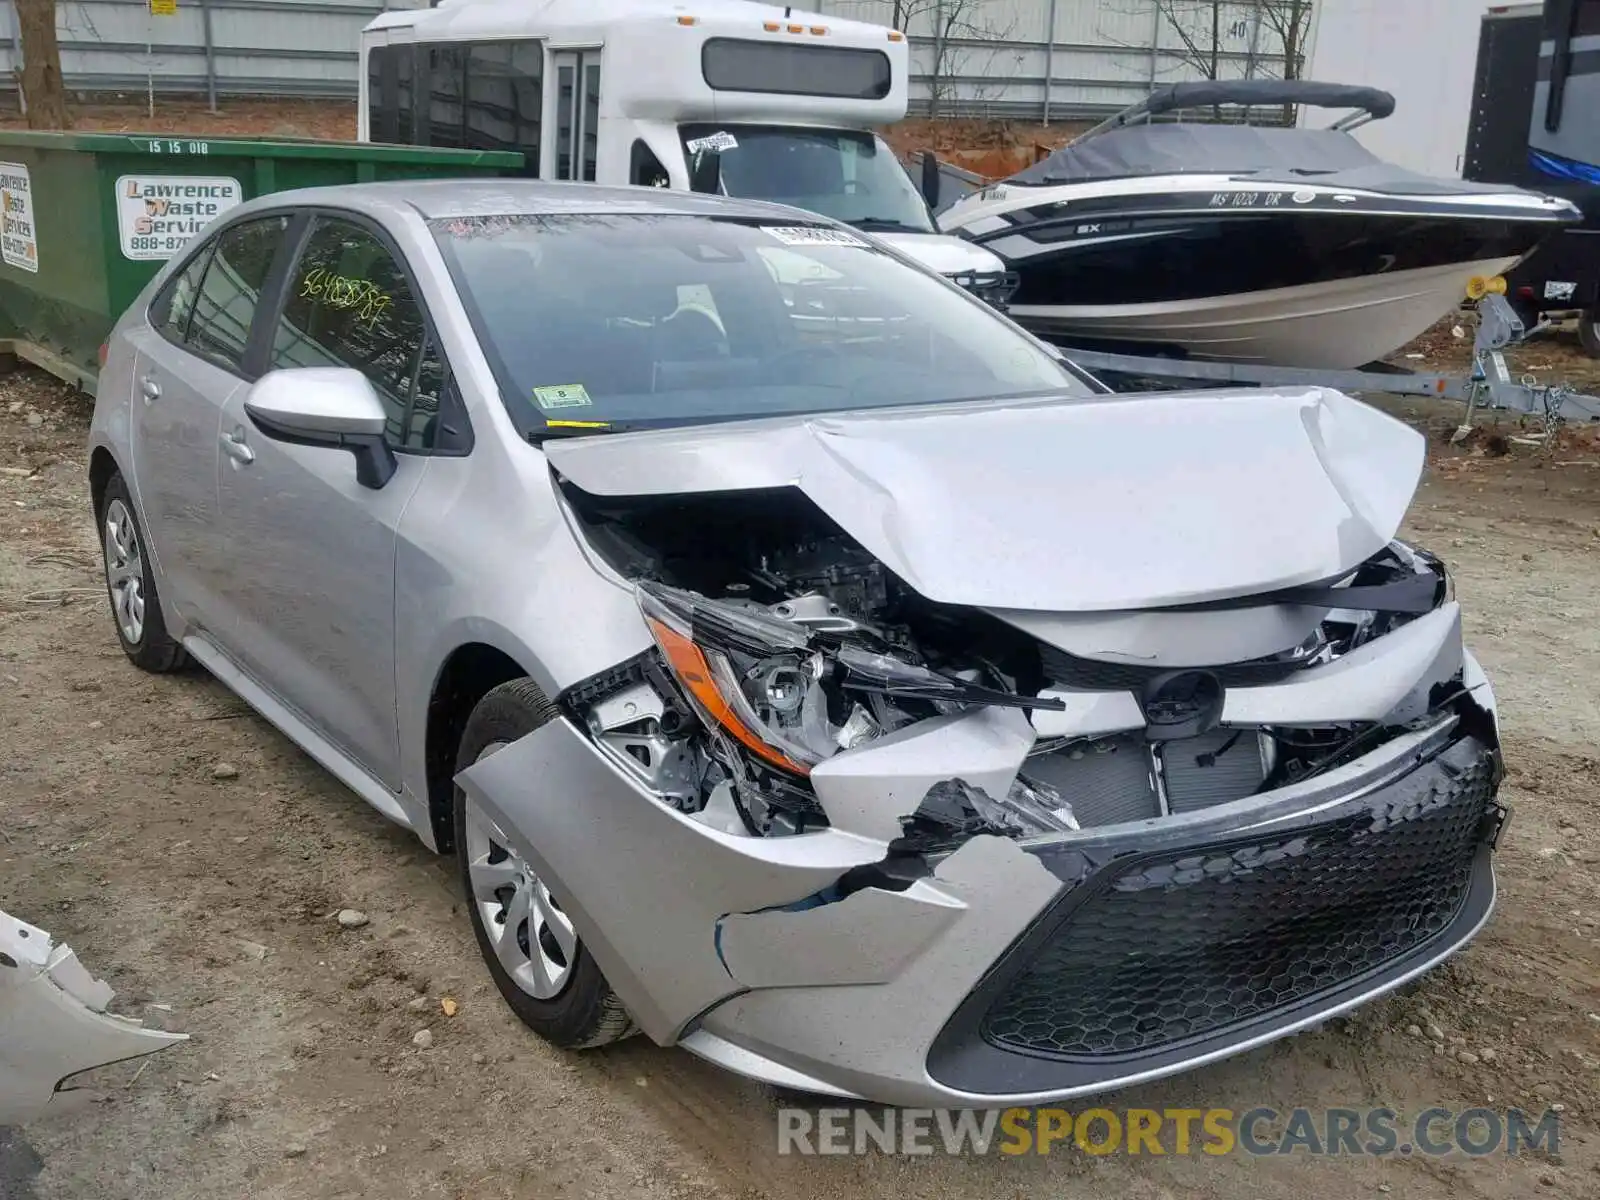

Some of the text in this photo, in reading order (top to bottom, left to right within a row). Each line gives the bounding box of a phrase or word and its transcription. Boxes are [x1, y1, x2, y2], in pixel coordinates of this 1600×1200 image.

[149, 141, 161, 153] 15
[169, 142, 181, 153] 15
[126, 180, 232, 198] Lawrence
[144, 199, 217, 217] Waste
